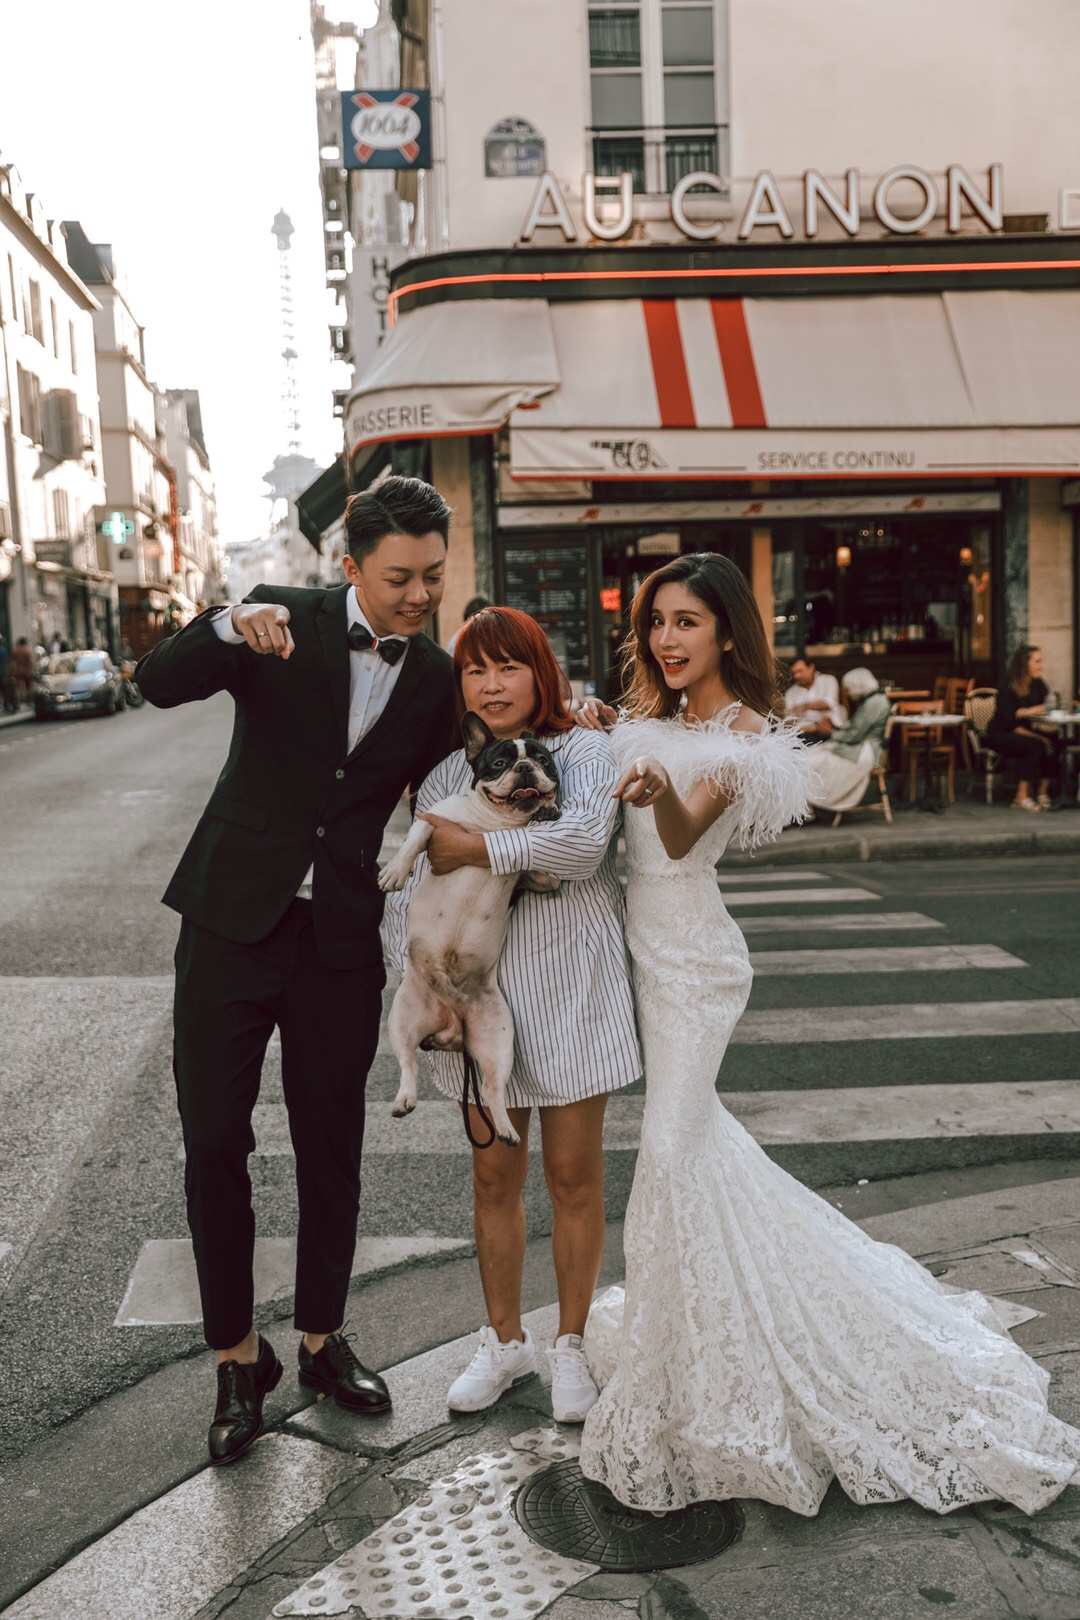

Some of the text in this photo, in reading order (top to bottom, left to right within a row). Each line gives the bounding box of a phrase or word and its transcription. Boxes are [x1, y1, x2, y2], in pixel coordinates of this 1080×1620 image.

[519, 170, 633, 243] AU
[671, 163, 1004, 240] CANON
[757, 450, 915, 469] SERVICE CONTINU
